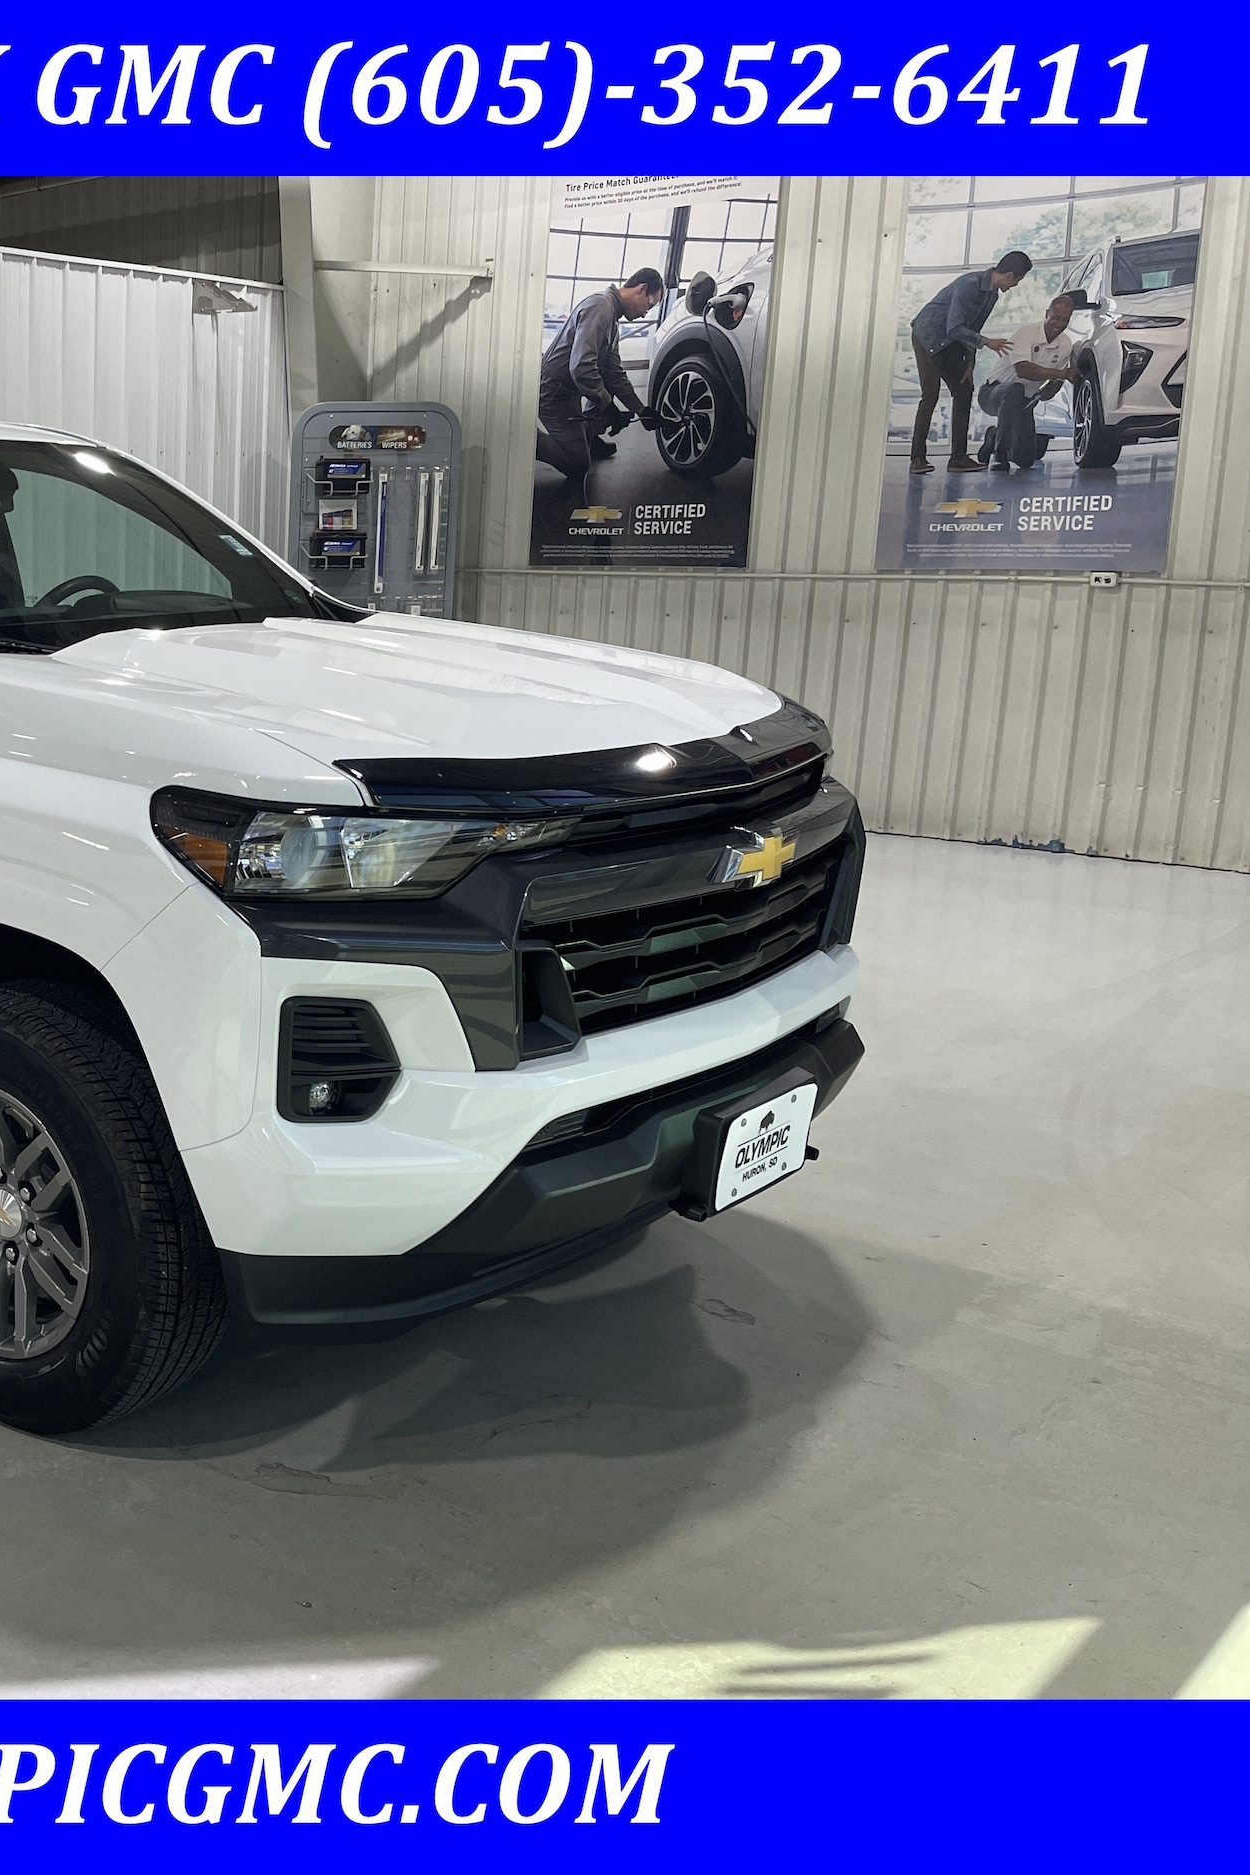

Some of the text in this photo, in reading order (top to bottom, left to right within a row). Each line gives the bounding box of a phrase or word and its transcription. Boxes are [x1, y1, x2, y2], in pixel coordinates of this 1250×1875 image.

[565, 181, 581, 192] Tire
[583, 180, 604, 190] Price
[606, 177, 631, 188] Match
[337, 441, 372, 449] BATTERIES
[381, 441, 407, 449] WIPERS
[635, 504, 706, 519] CERTIFIED
[1019, 495, 1113, 513] CERTIFIED
[634, 520, 693, 535] SERVICE
[929, 523, 1004, 532] CHEVROLET
[1017, 515, 1095, 531] SERVICE
[568, 527, 624, 536] CHEVROLET
[735, 1125, 791, 1169] OLYMPIC
[742, 1156, 778, 1182] HURON, SD
